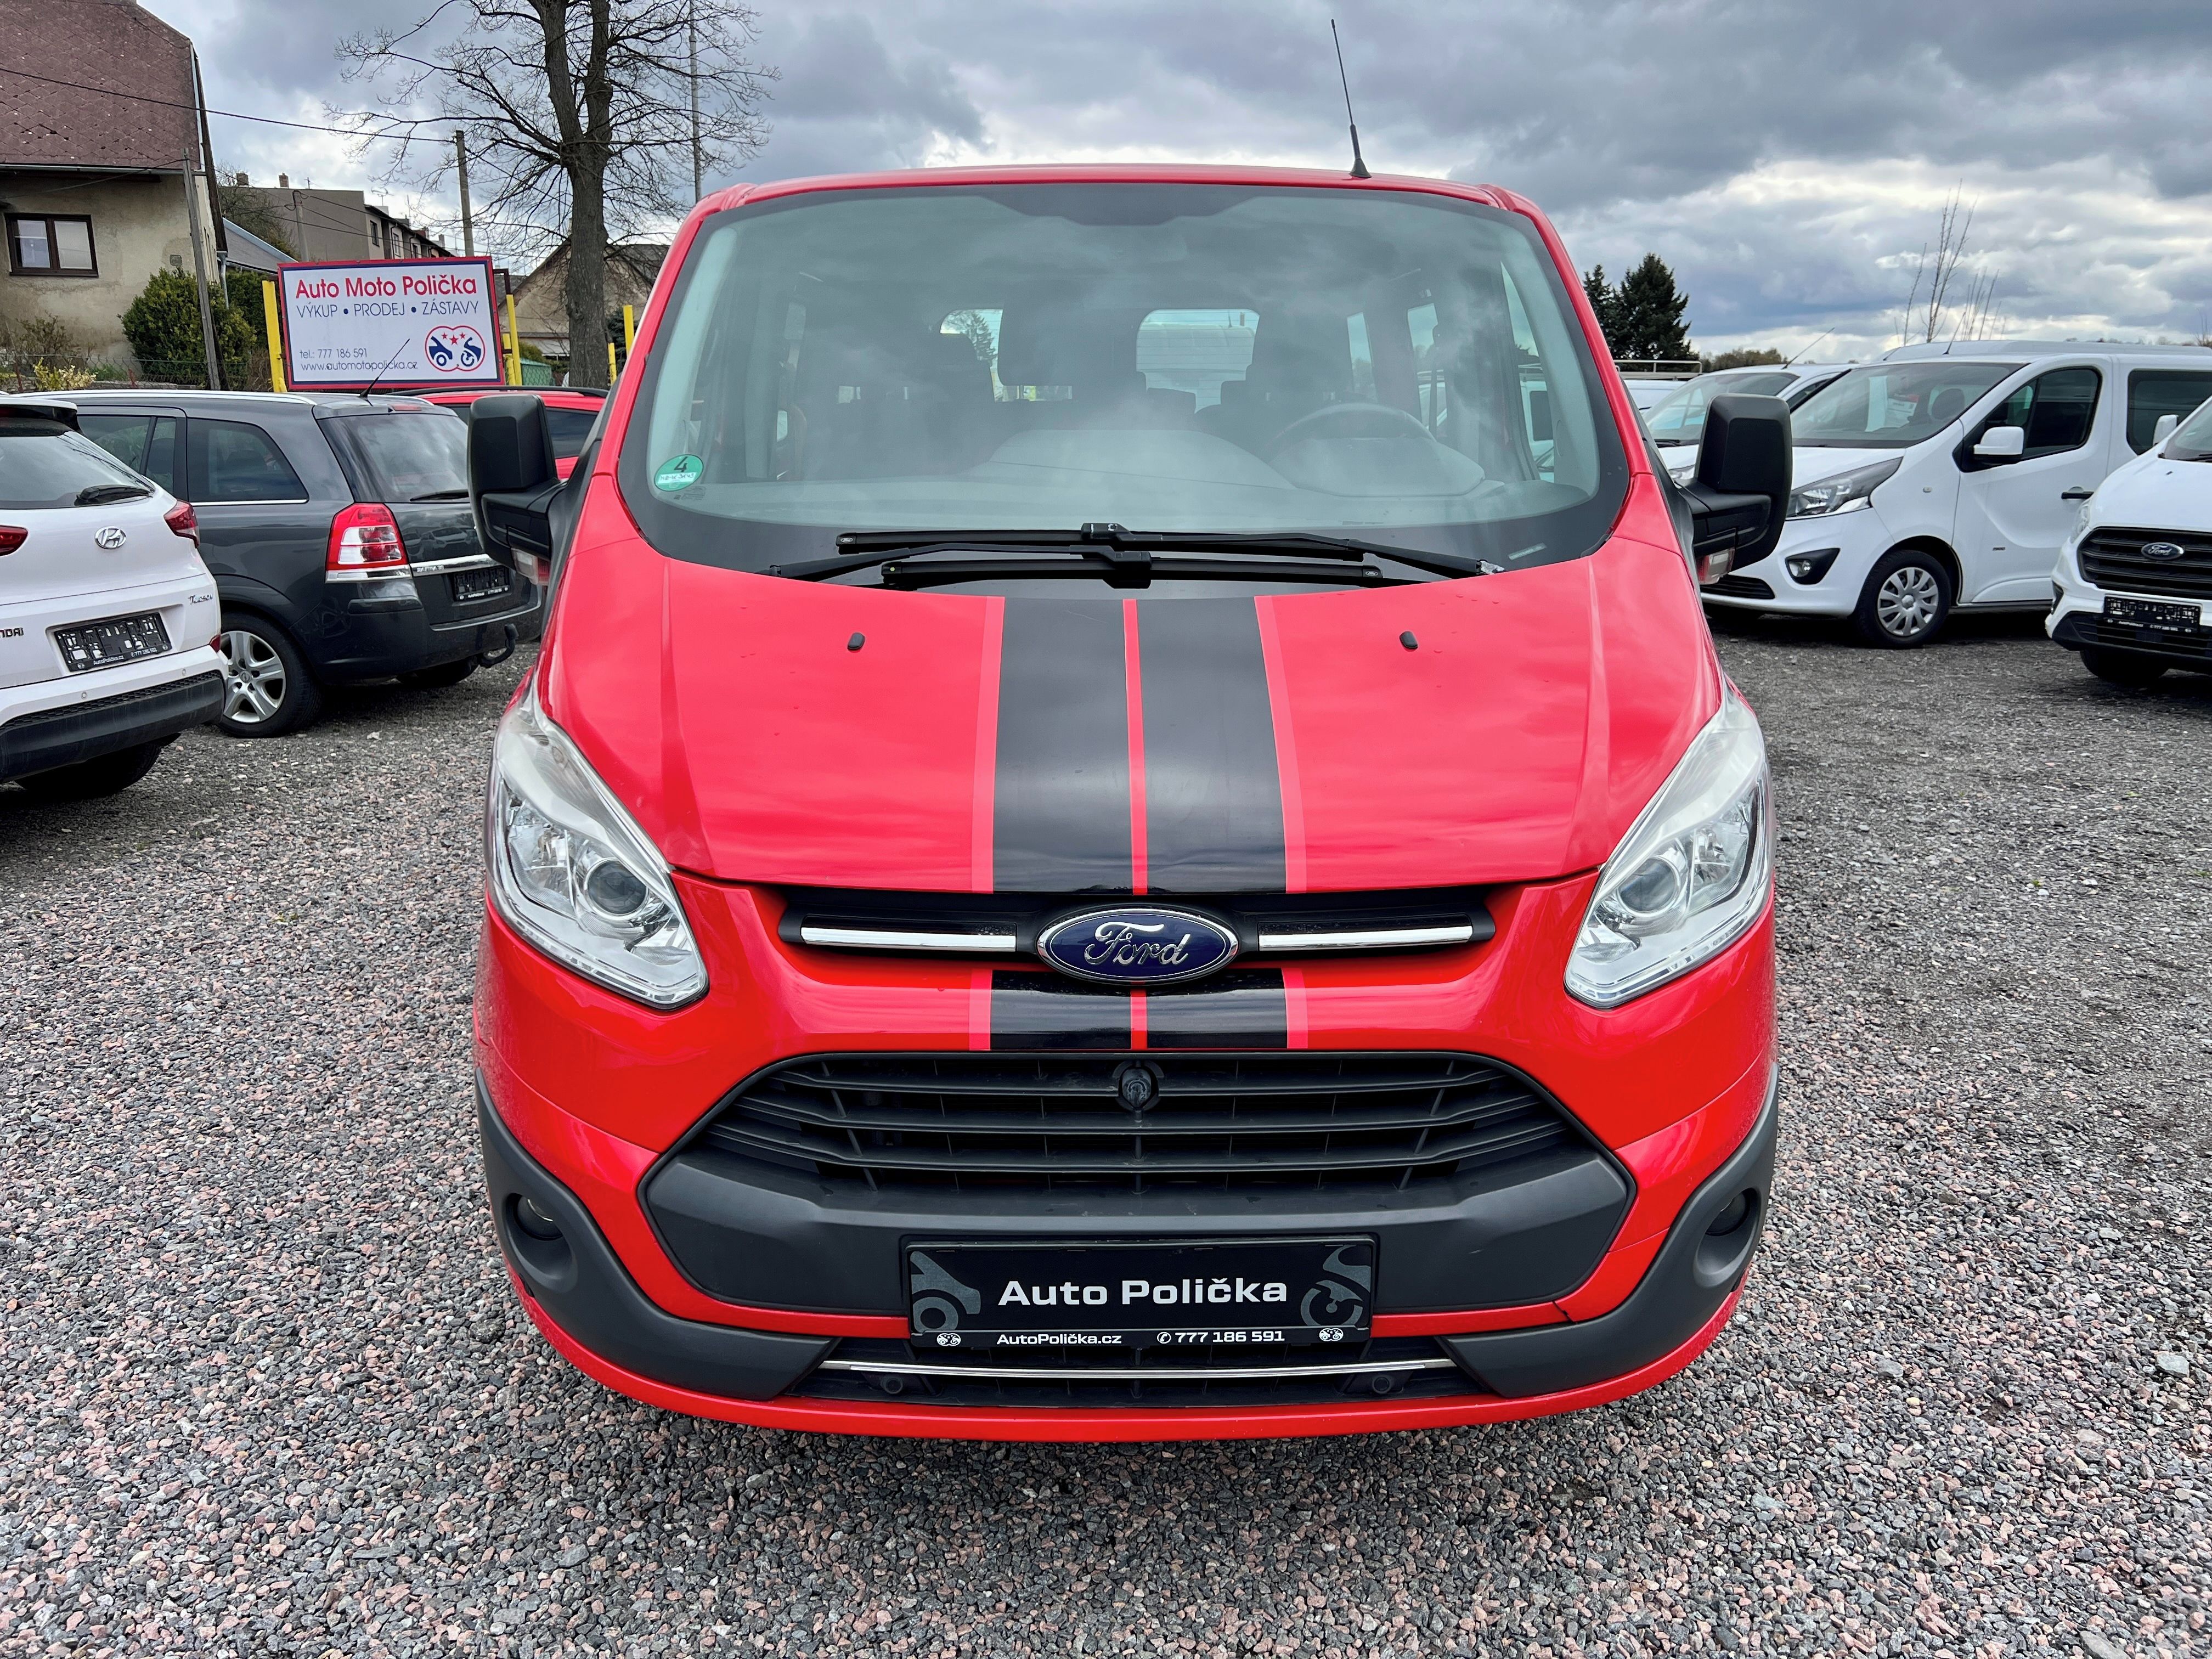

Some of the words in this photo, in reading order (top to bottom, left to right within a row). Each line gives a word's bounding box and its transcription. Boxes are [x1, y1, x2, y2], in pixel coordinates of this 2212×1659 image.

[296, 279, 339, 298] Auto
[345, 276, 397, 297] Moto
[402, 274, 477, 295] Polička
[296, 302, 337, 318] VÝKUP
[354, 303, 405, 317] PRODEJ
[422, 298, 479, 315] ZÁSTAVY
[300, 349, 315, 359] tel.:
[318, 349, 332, 358] 777
[337, 348, 351, 358] 186
[353, 348, 368, 358] 591
[674, 456, 688, 472] 4
[2148, 544, 2172, 555] Ford
[1084, 921, 1190, 966] Ford
[997, 1280, 1108, 1306] Auto
[1122, 1278, 1286, 1305] Polička
[996, 1333, 1122, 1345] AutoPolička.cz
[1175, 1332, 1209, 1343] 777
[1212, 1331, 1246, 1342] 186
[1251, 1330, 1285, 1342] 591
